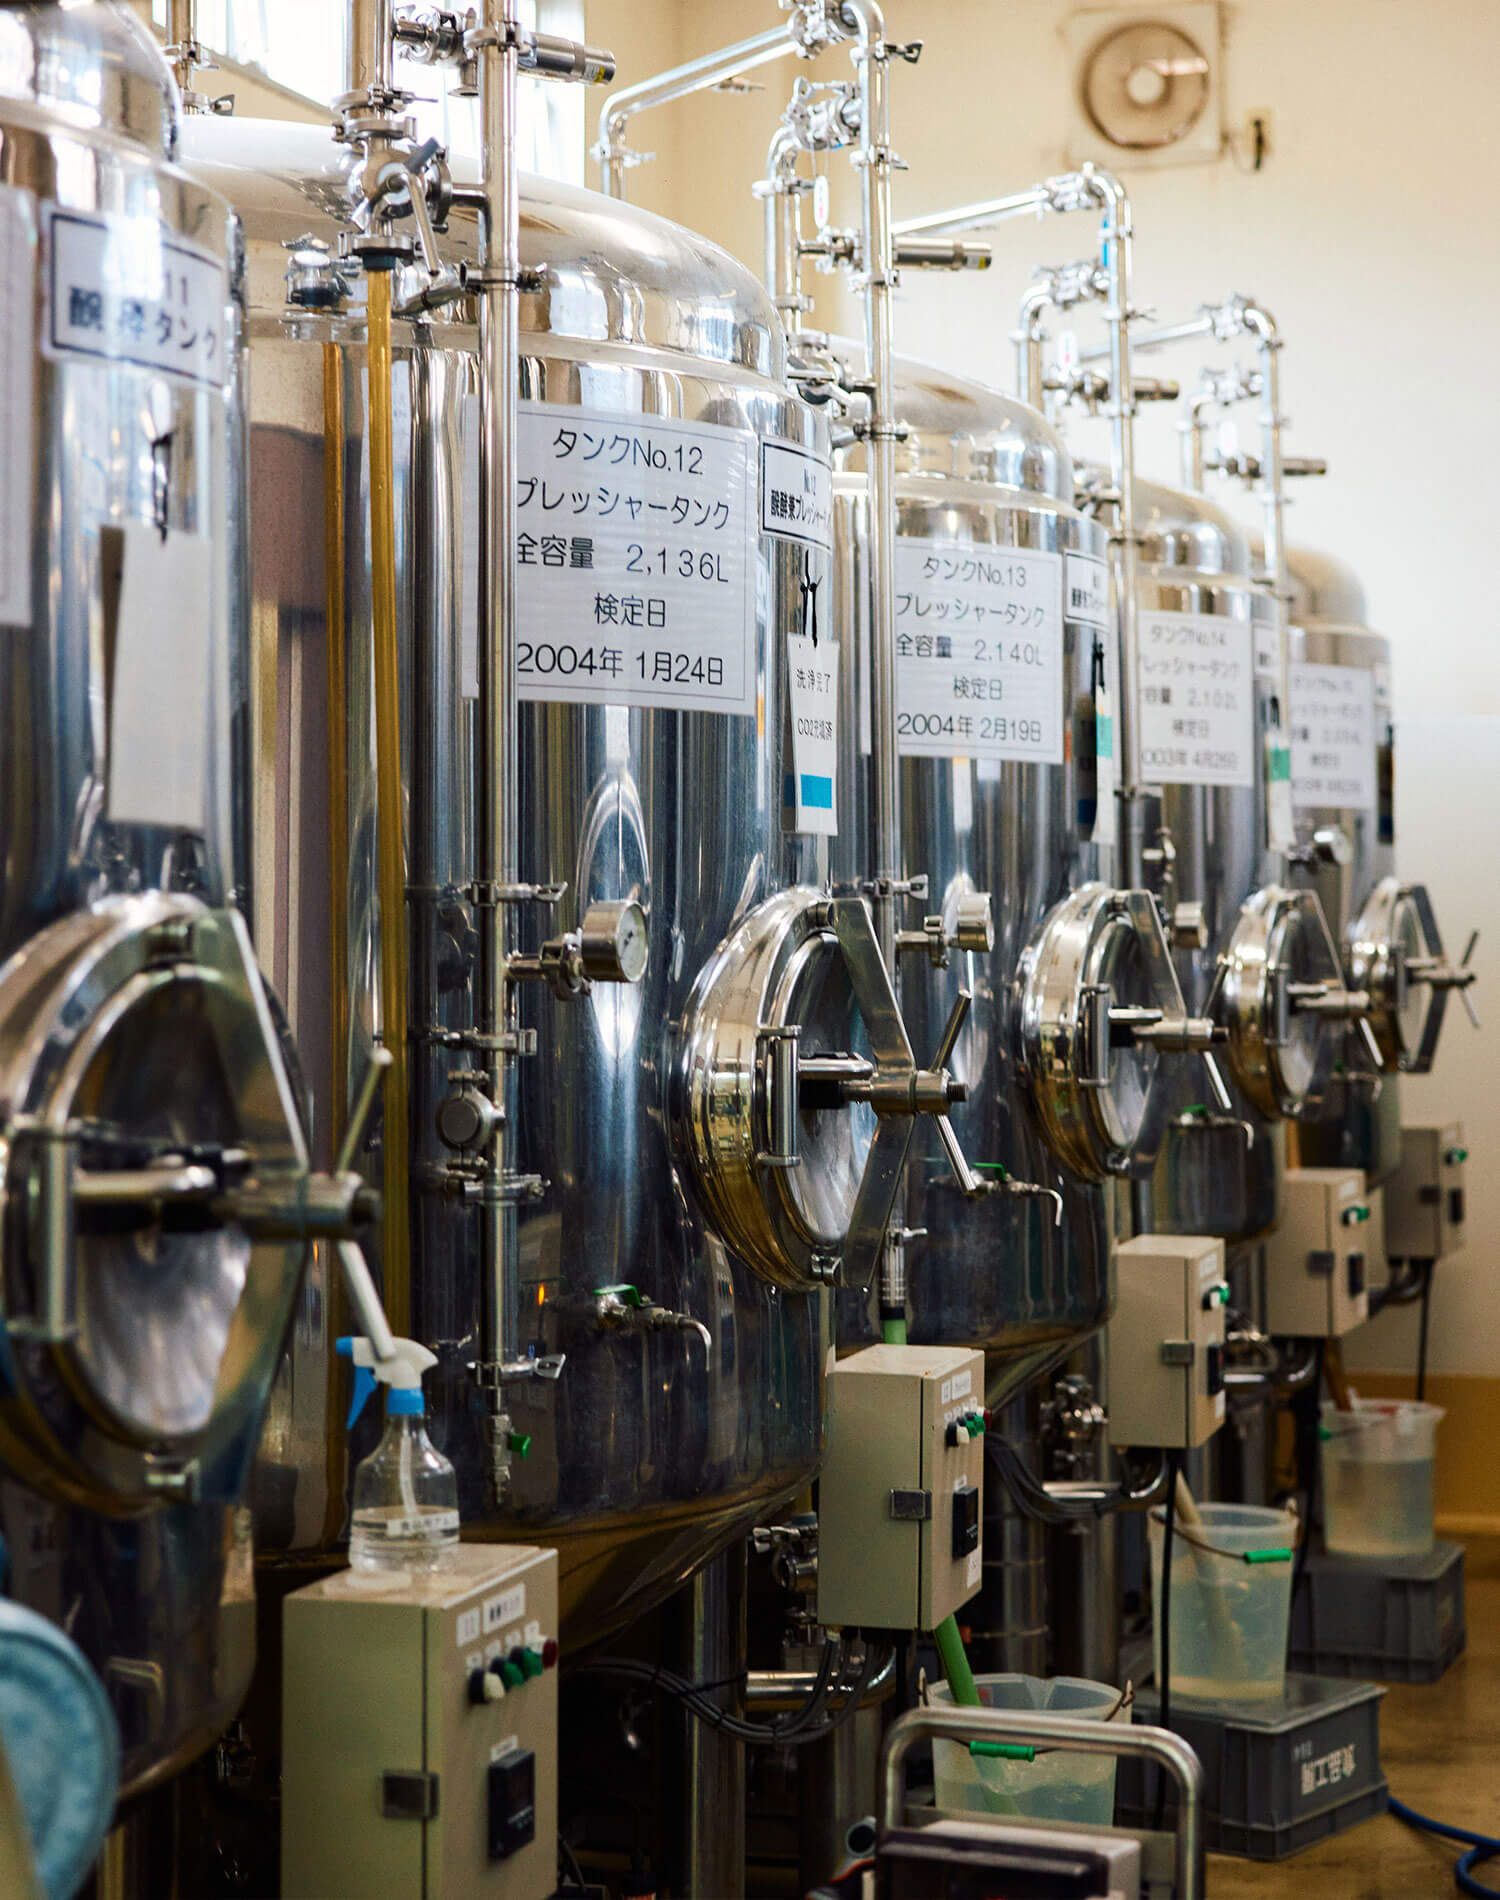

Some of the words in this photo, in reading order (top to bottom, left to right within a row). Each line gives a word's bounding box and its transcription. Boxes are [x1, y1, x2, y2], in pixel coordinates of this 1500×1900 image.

[552, 427, 705, 476] タンクNo.12
[517, 476, 731, 531] プレッシャータンク
[517, 532, 595, 570] 全容量
[625, 542, 730, 584] 2,136L
[922, 556, 1027, 588] タンクNo.13
[594, 592, 667, 629] 検定日
[896, 592, 1044, 629] プレッシャータンク
[896, 632, 953, 659] 全容量
[517, 642, 624, 681] 2004年
[635, 651, 724, 687] 1月24日
[953, 676, 1003, 701] 検定日
[897, 712, 974, 740] 2004年
[979, 717, 1042, 743] 2月19日
